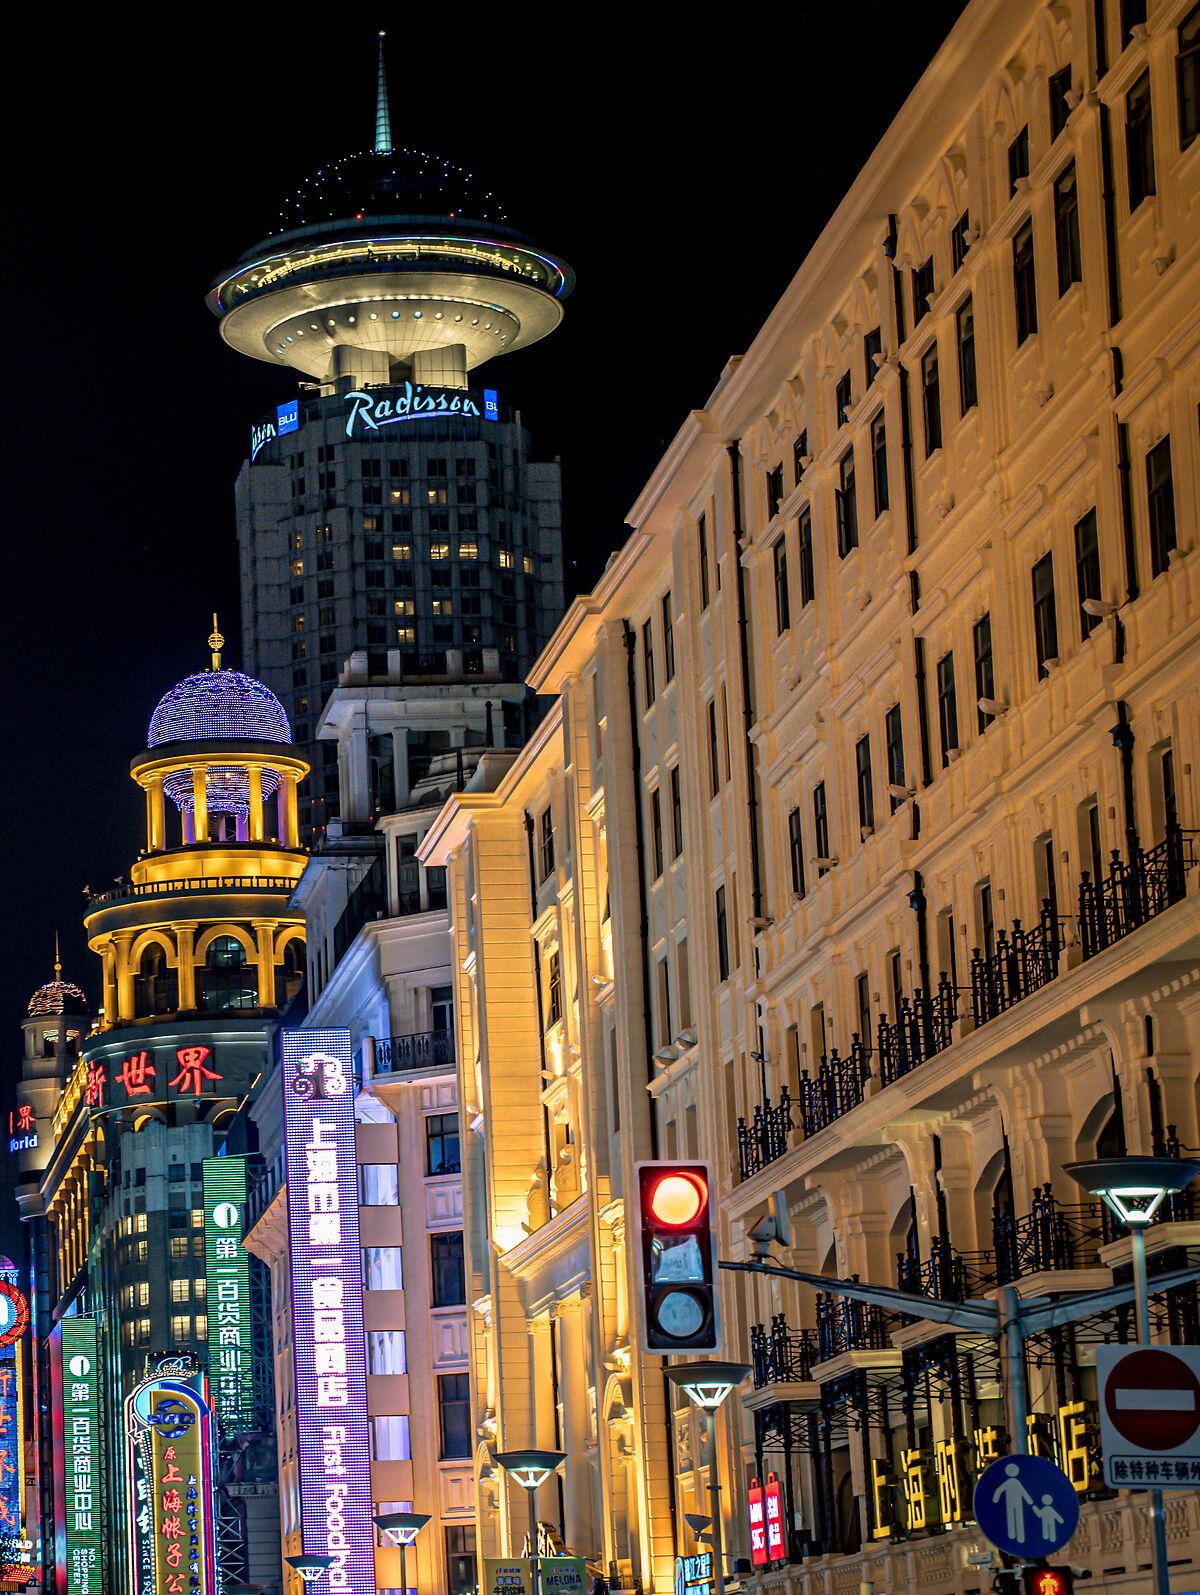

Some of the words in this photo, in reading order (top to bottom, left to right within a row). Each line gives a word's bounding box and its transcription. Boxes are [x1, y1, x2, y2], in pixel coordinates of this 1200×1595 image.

[278, 411, 297, 426] BLU
[344, 381, 480, 437] Radisson
[86, 1046, 223, 1108] 新世界
[71, 1383, 93, 1531] 第一百货商业中心
[323, 1426, 347, 1475] First
[872, 1400, 1089, 1539] 上海时装店
[73, 1548, 81, 1585] CENTER
[81, 1548, 89, 1595] SHOPPING
[88, 1548, 96, 1568] NO.1
[142, 1539, 151, 1570] SINCE
[546, 1574, 582, 1586] MELONA
